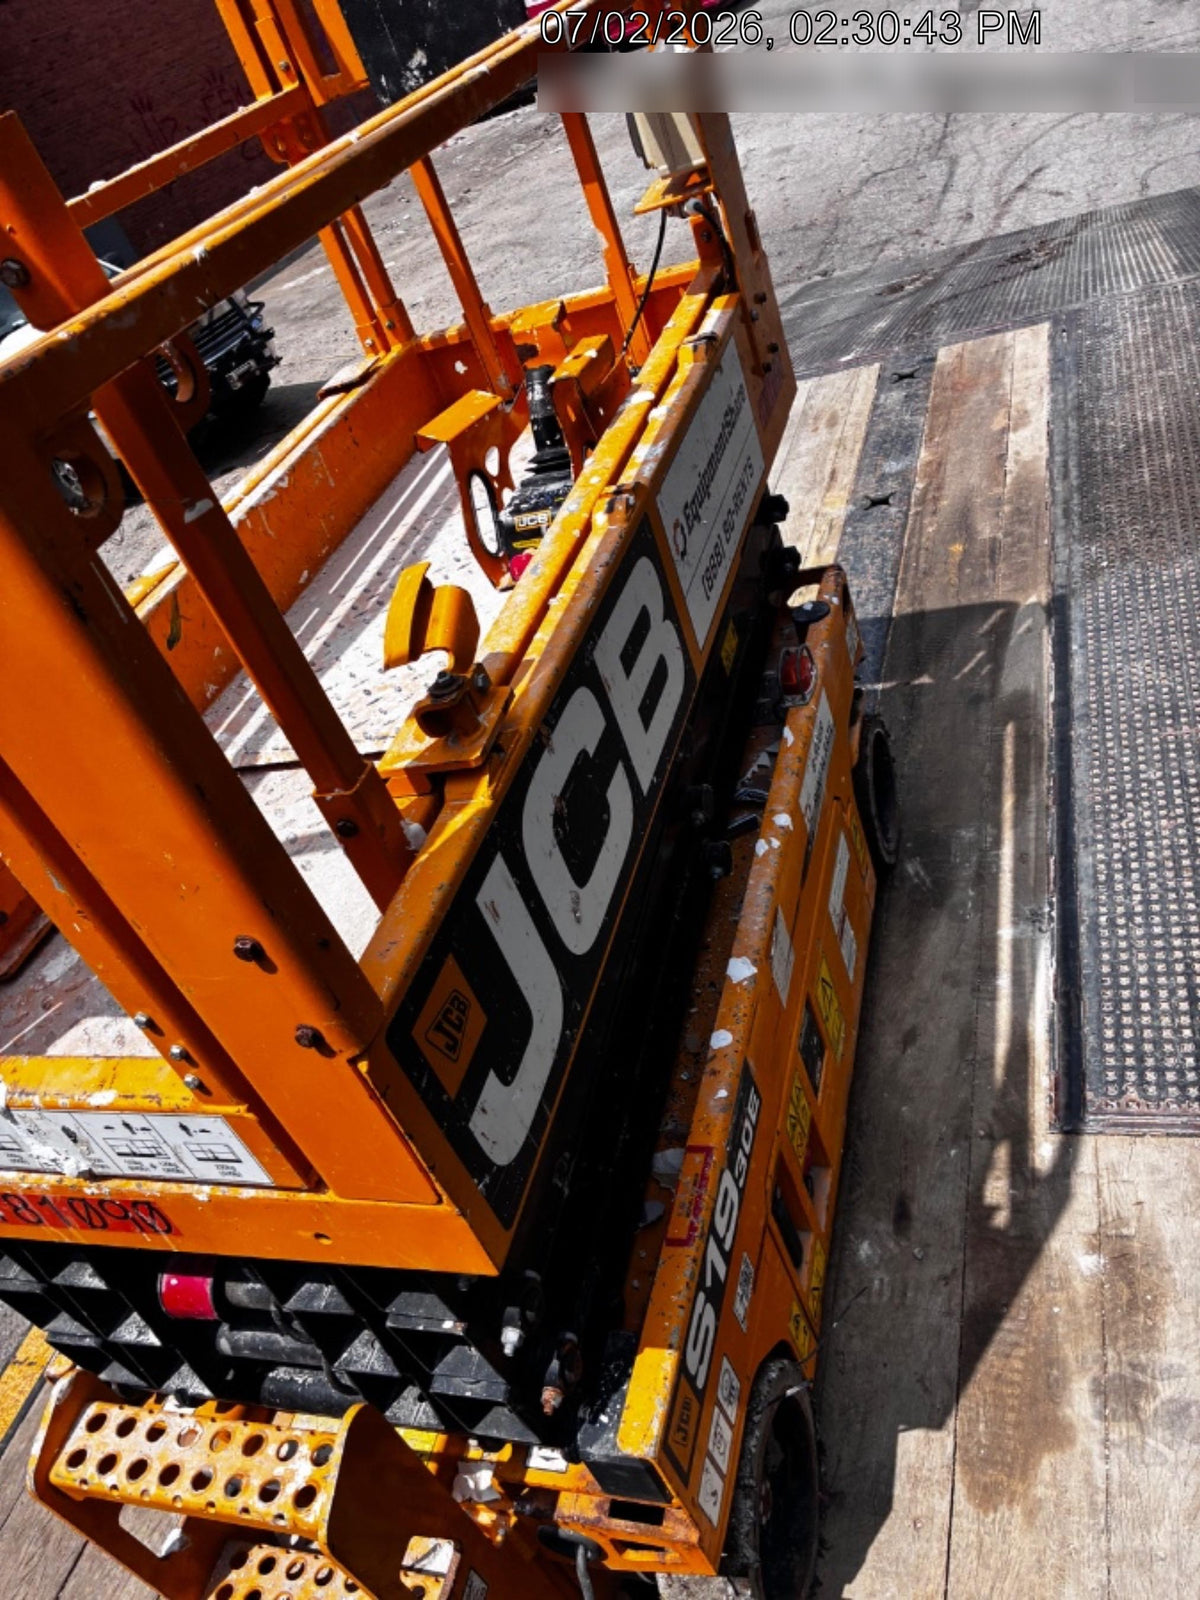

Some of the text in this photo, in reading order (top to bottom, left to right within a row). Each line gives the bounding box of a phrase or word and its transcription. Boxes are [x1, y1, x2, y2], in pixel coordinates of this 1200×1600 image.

[518, 512, 548, 527] JCB
[469, 556, 685, 1165] JCB
[431, 994, 468, 1054] JCB
[0, 1193, 173, 1235] 81090
